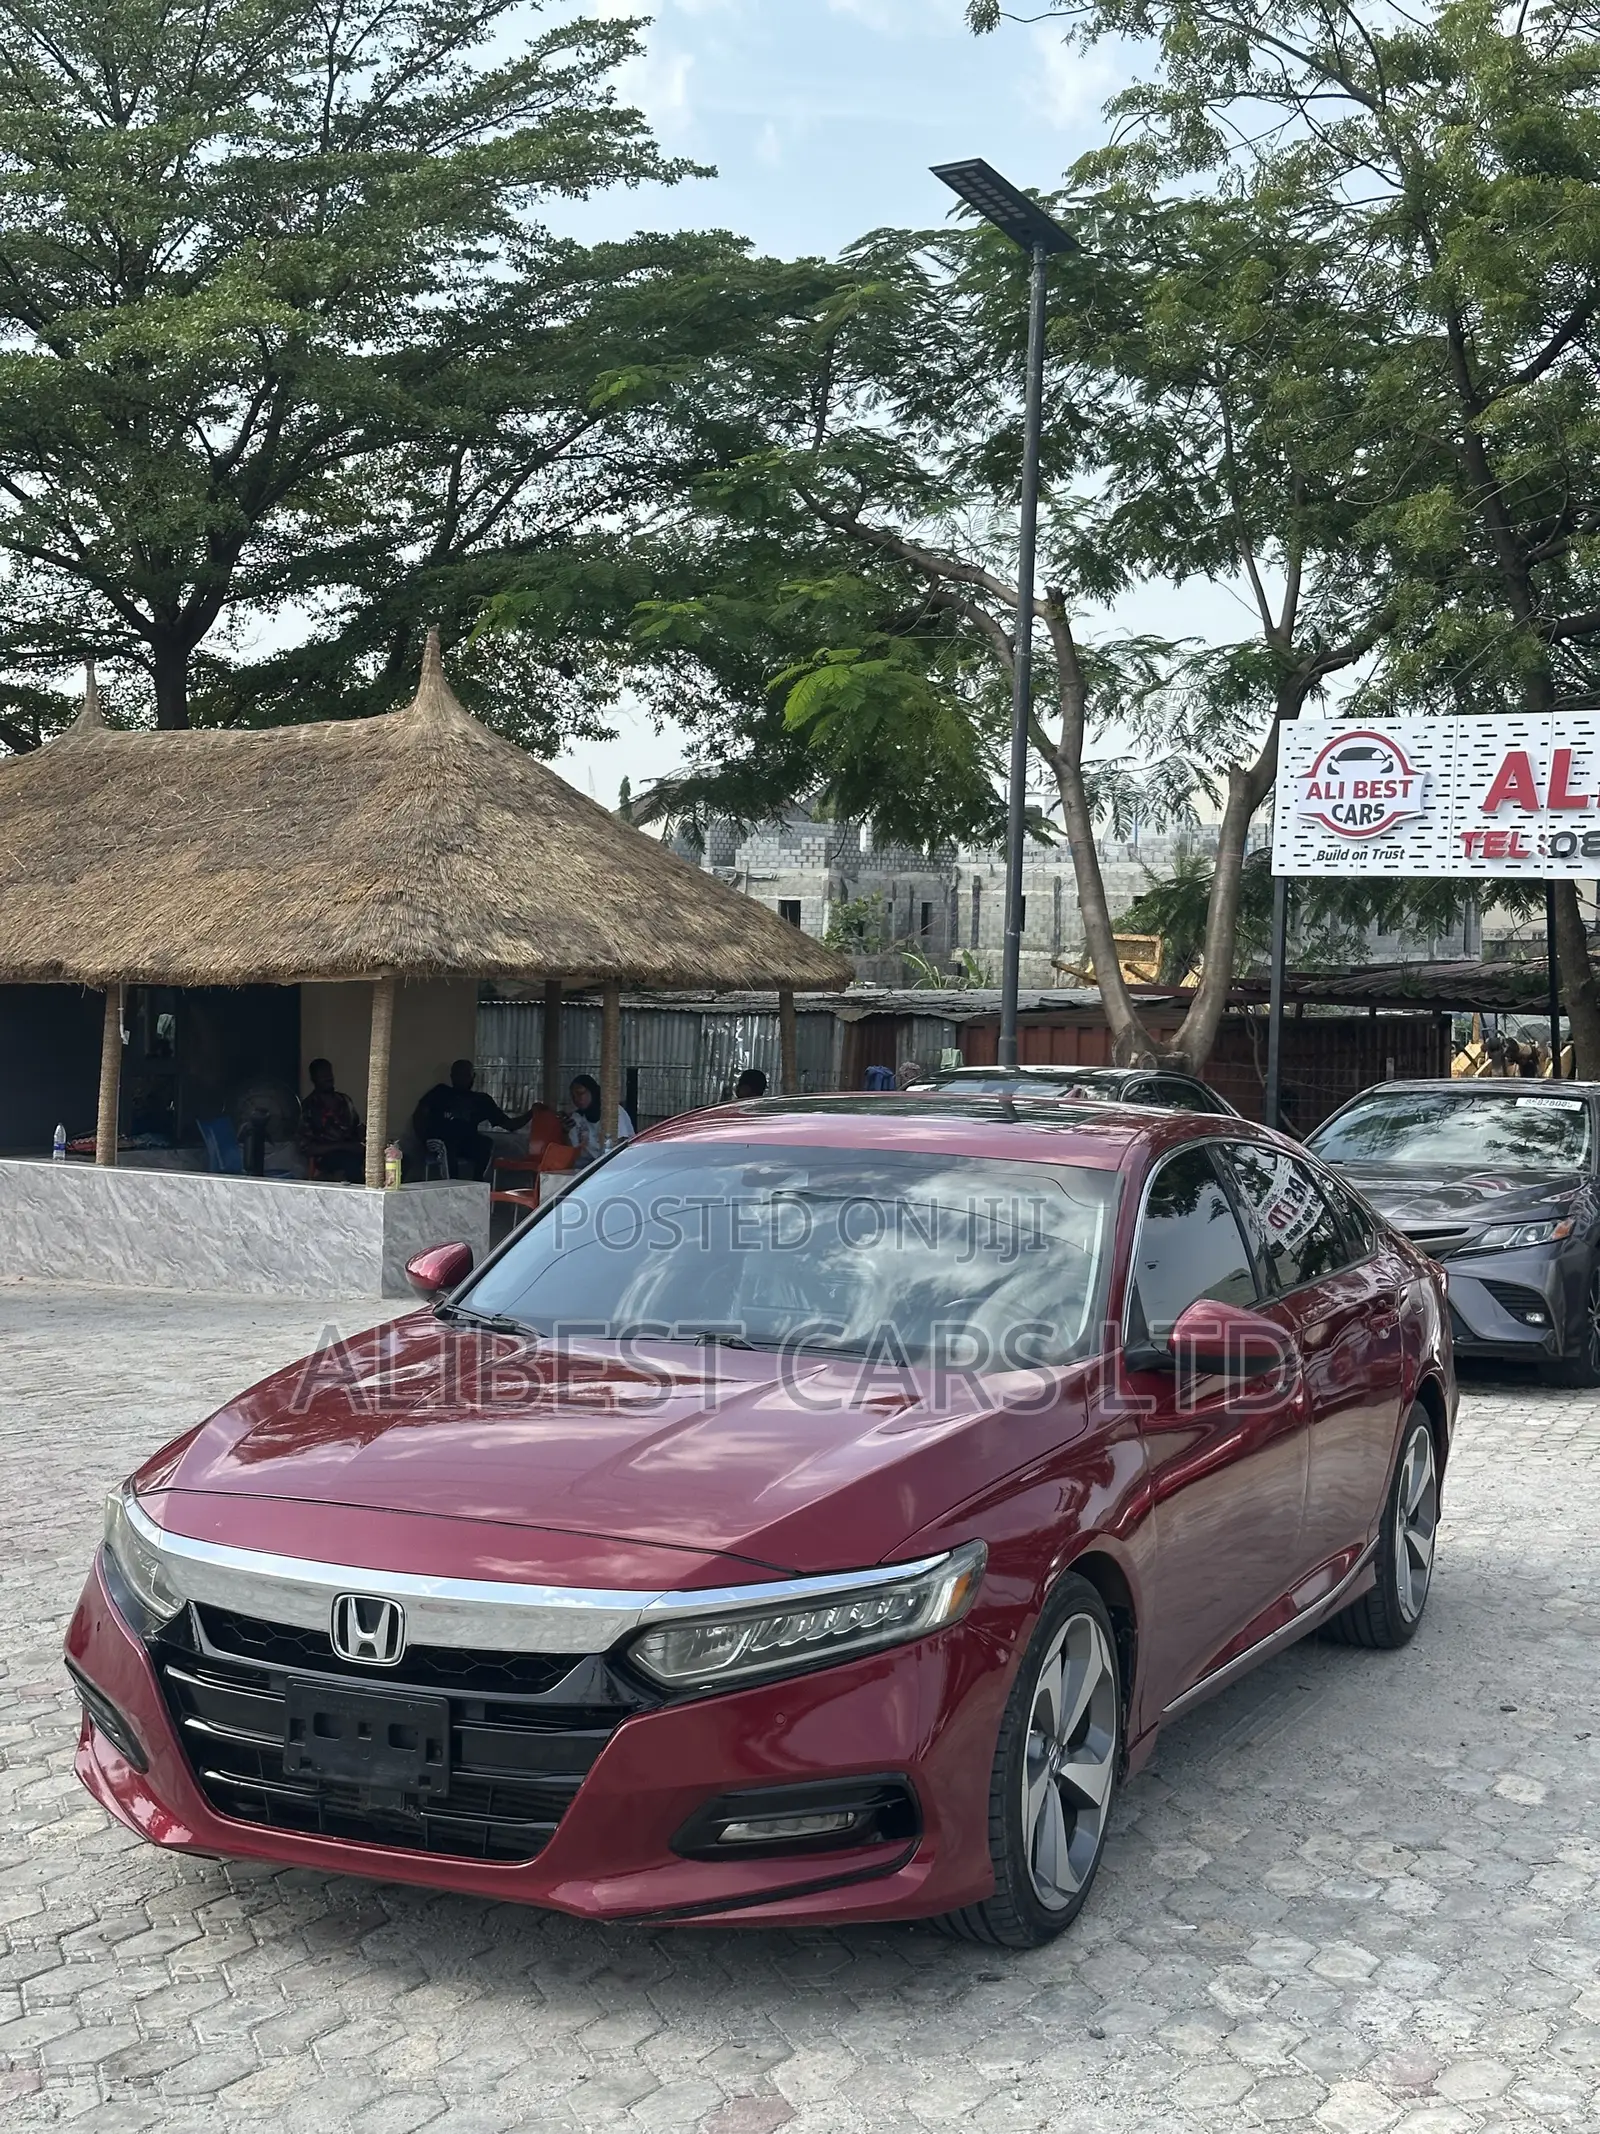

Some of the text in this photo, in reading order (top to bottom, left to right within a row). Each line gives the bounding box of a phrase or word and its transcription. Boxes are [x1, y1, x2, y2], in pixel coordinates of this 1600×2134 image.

[1305, 780, 1414, 800] ALI BEST
[1480, 748, 1600, 812] AL
[1331, 803, 1385, 826] CARS
[1316, 848, 1405, 861] Build on Trust
